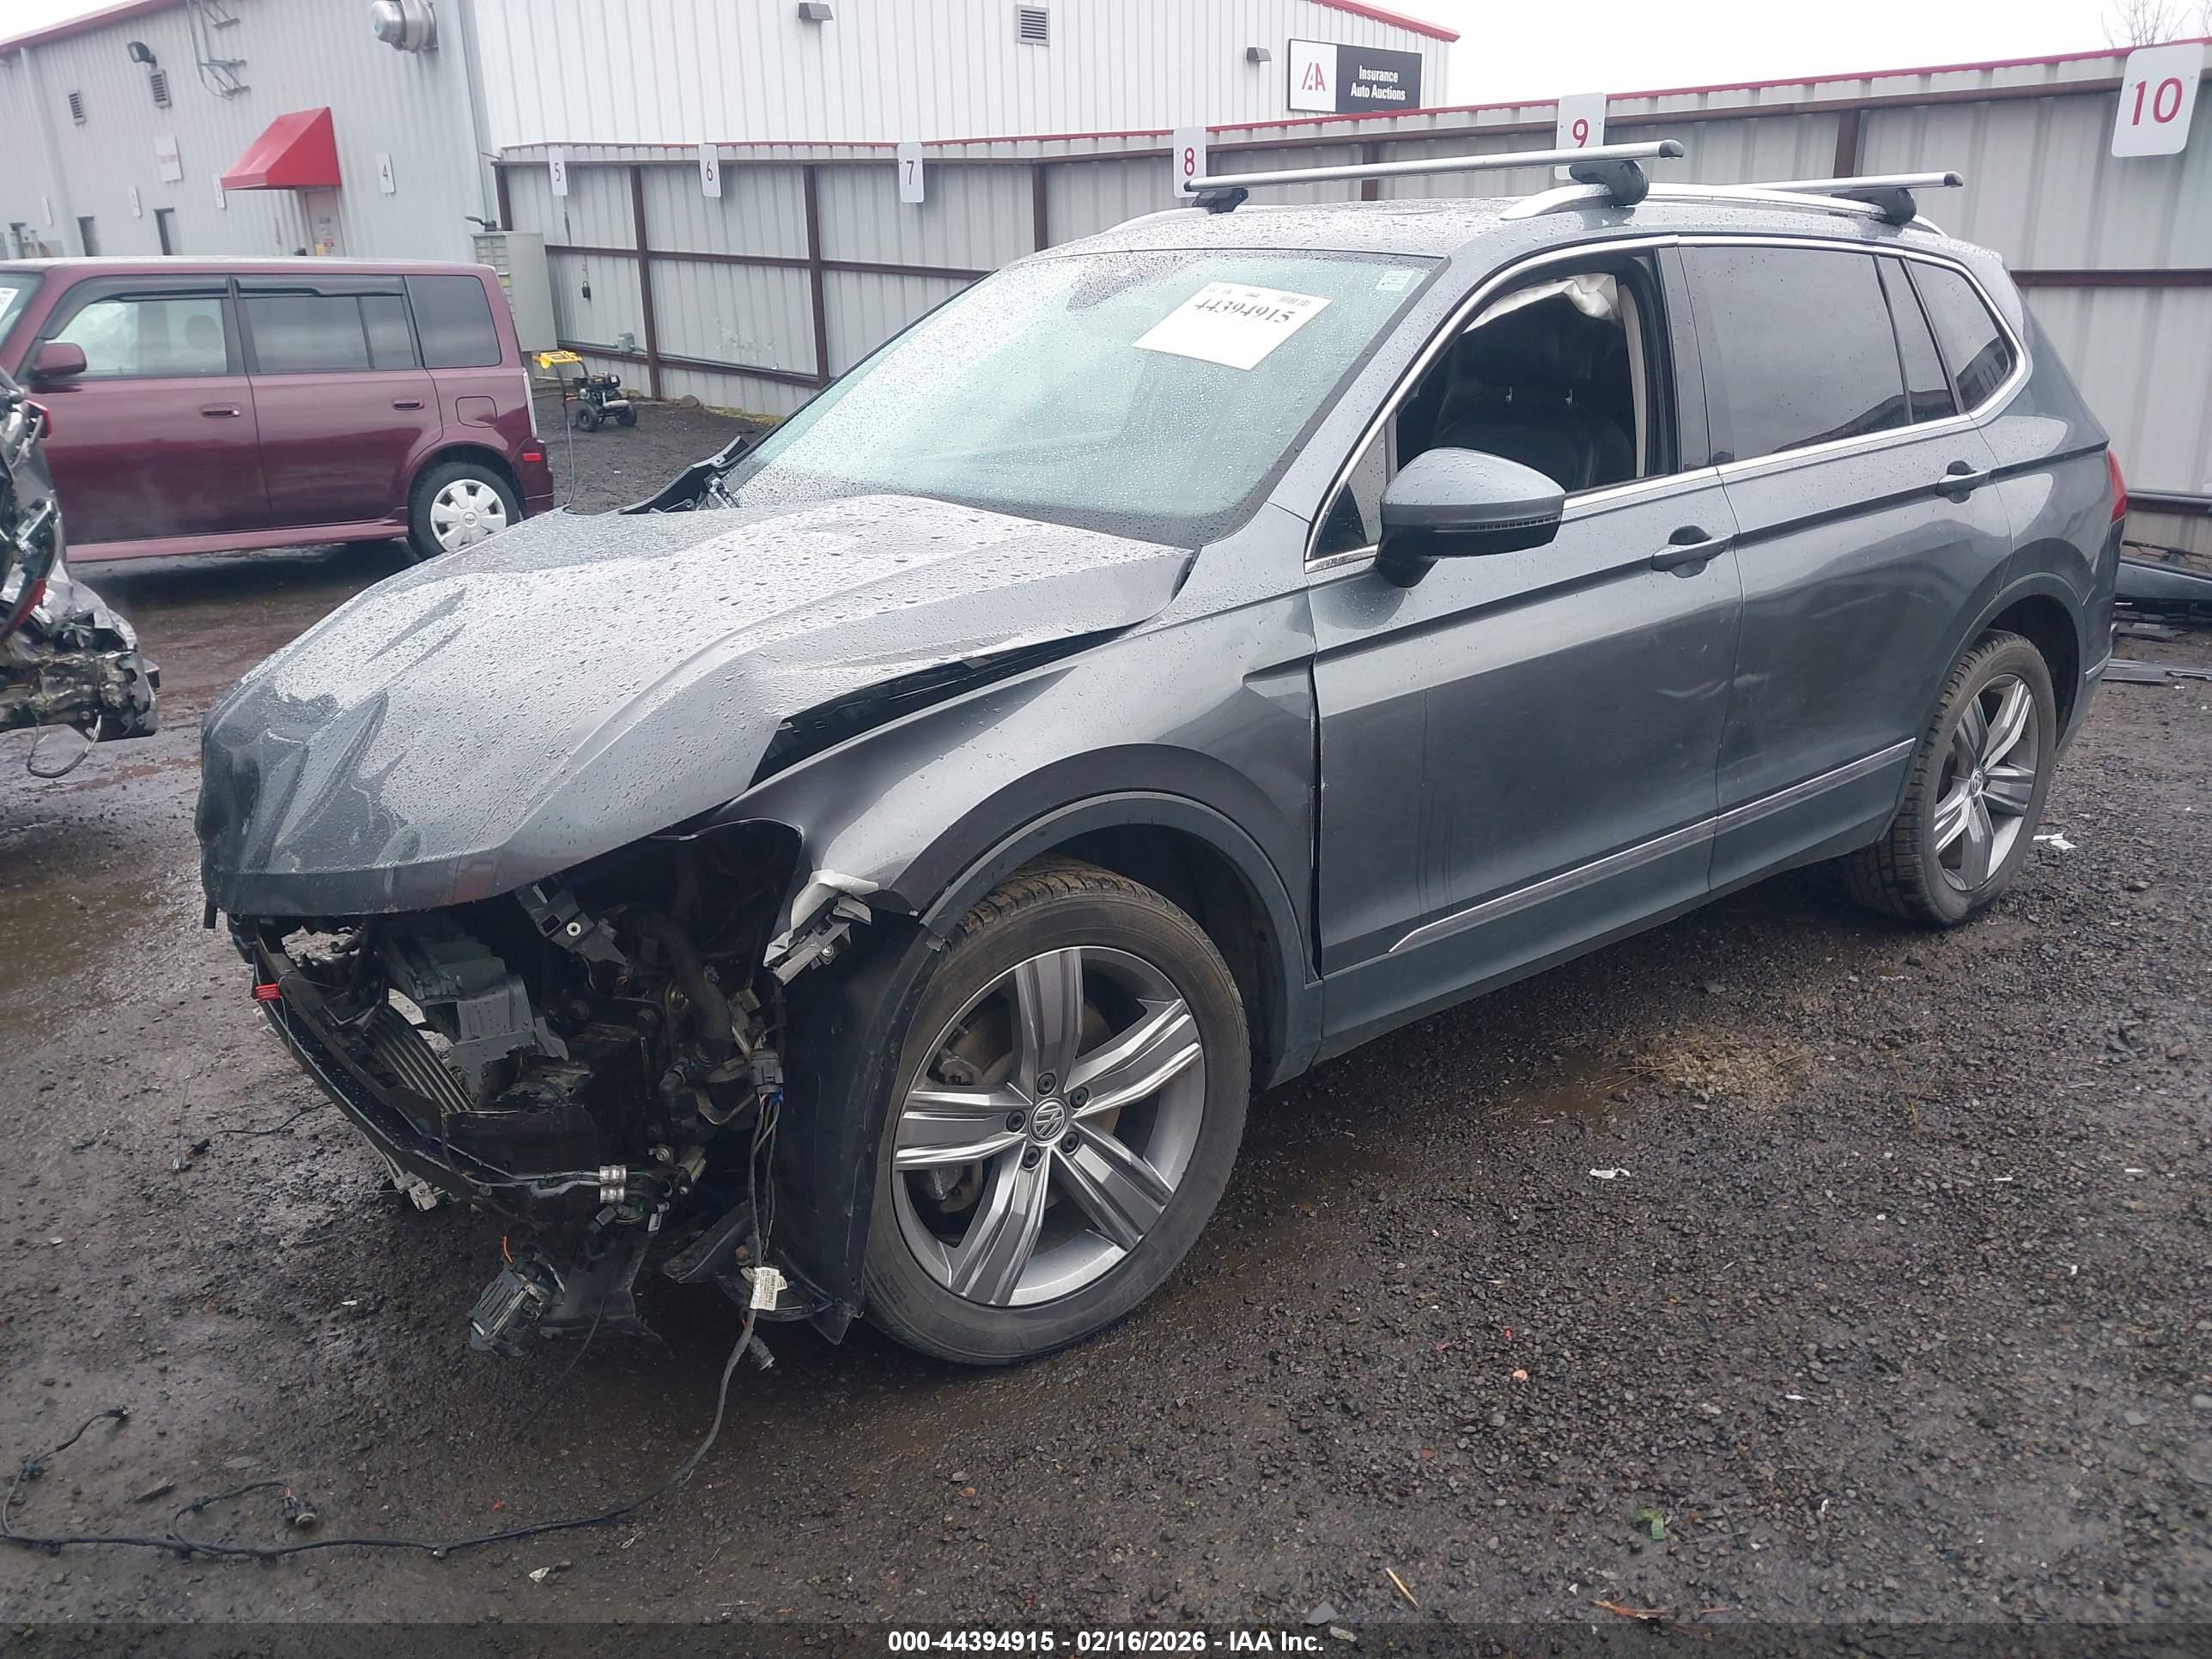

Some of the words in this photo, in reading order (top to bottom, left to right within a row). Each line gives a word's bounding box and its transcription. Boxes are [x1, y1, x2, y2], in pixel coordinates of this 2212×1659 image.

[1358, 65, 1399, 82] Insurance
[1351, 82, 1370, 98] Auto
[1371, 84, 1406, 101] Auctions
[2132, 77, 2182, 125] 10
[1572, 118, 1589, 149] 9
[554, 162, 561, 182] 5
[707, 161, 714, 181] 6
[1184, 147, 1194, 176] 8
[382, 164, 389, 182] 4
[906, 161, 915, 185] 7
[1194, 298, 1296, 323] 44394915
